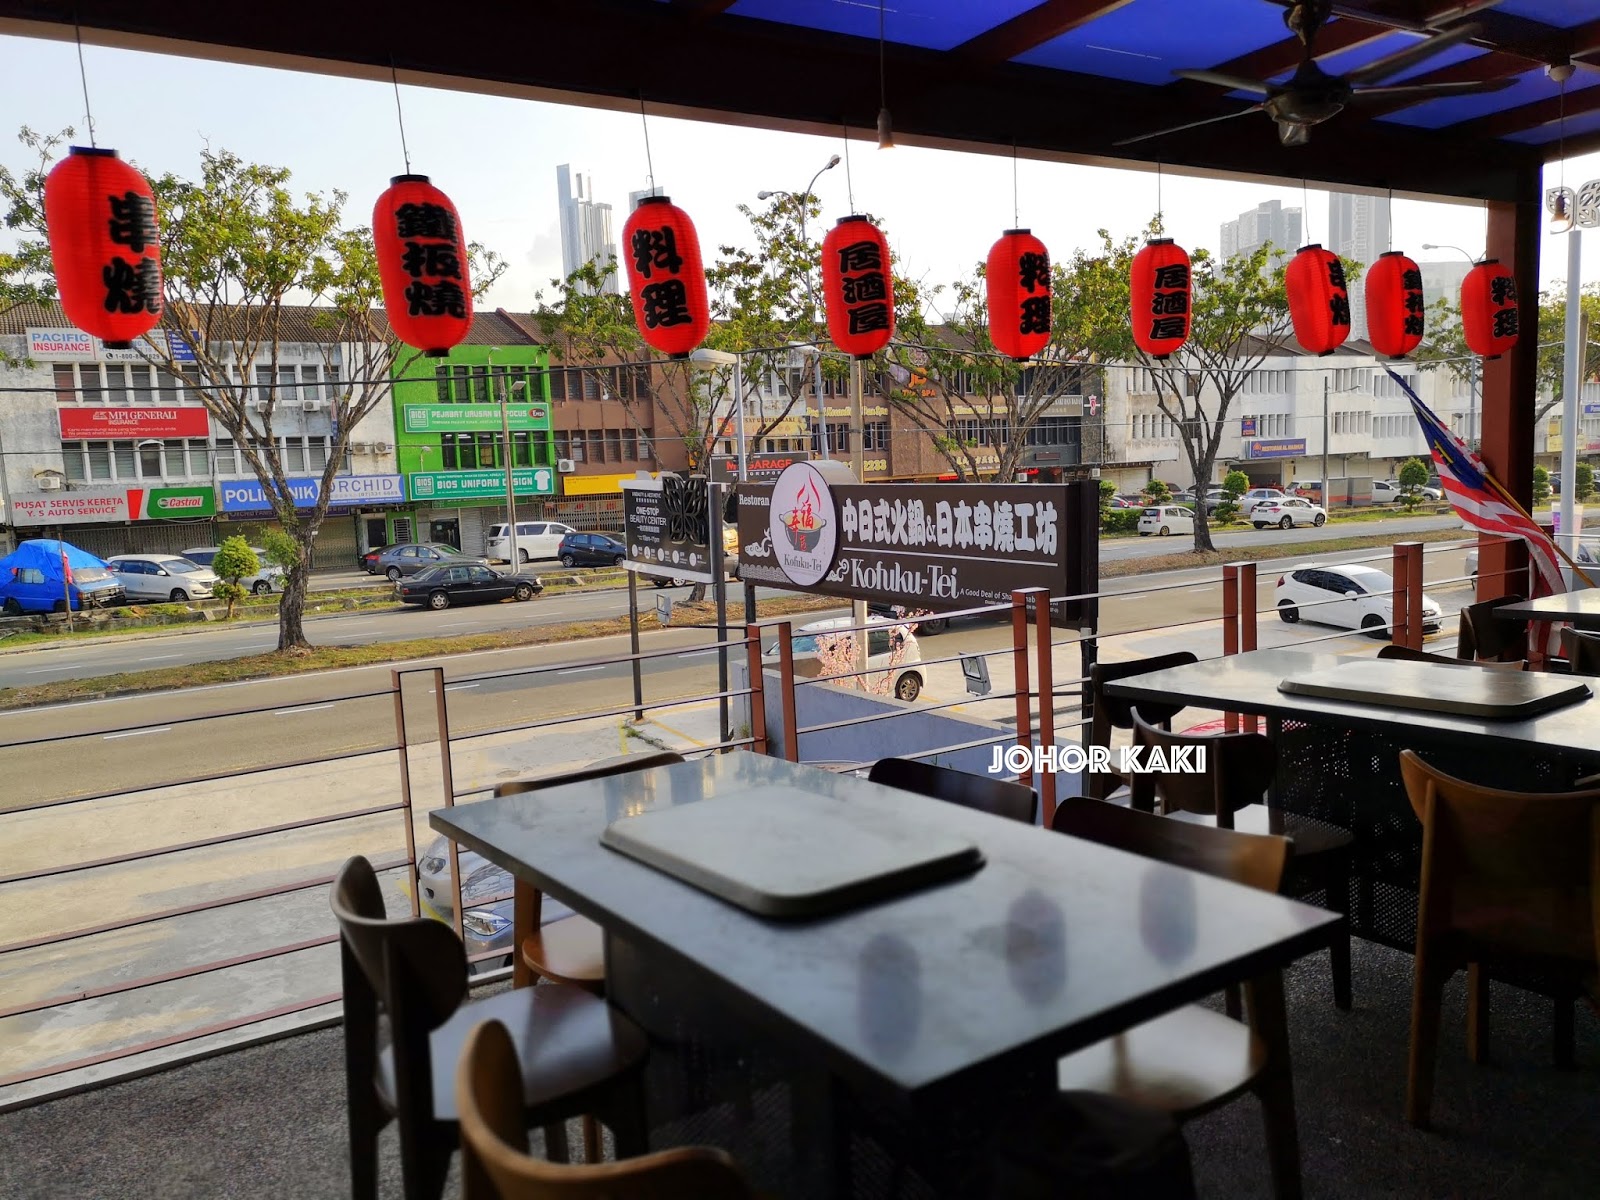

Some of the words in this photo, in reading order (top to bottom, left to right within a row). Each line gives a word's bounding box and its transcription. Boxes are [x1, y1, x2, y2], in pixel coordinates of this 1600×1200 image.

[632, 226, 693, 330] 料理
[837, 240, 891, 336] 居酒屋
[1150, 263, 1189, 341] 居酒屋
[32, 333, 90, 343] PACIFIC
[33, 343, 91, 351] INSURANCE
[129, 410, 177, 419] GENERALI
[437, 480, 458, 489] BIOS
[461, 479, 499, 488] UNIFORM
[502, 477, 533, 487] DSIGN
[225, 486, 315, 503] POLINIK
[739, 494, 770, 506] Restoran
[15, 500, 47, 509] PUSAT
[50, 499, 85, 508] SERVIS
[87, 497, 124, 507] KERETA
[168, 496, 202, 507] Castrol
[47, 508, 74, 516] AUTO
[77, 506, 117, 515] SERVICE
[629, 514, 648, 524] BEAUTY
[647, 517, 667, 526] CENTER
[784, 554, 822, 571] Kofuku-Tei
[850, 558, 960, 599] Kofuku-Tei
[966, 590, 980, 598] Good
[980, 590, 993, 598] Deal
[994, 591, 1001, 599] of
